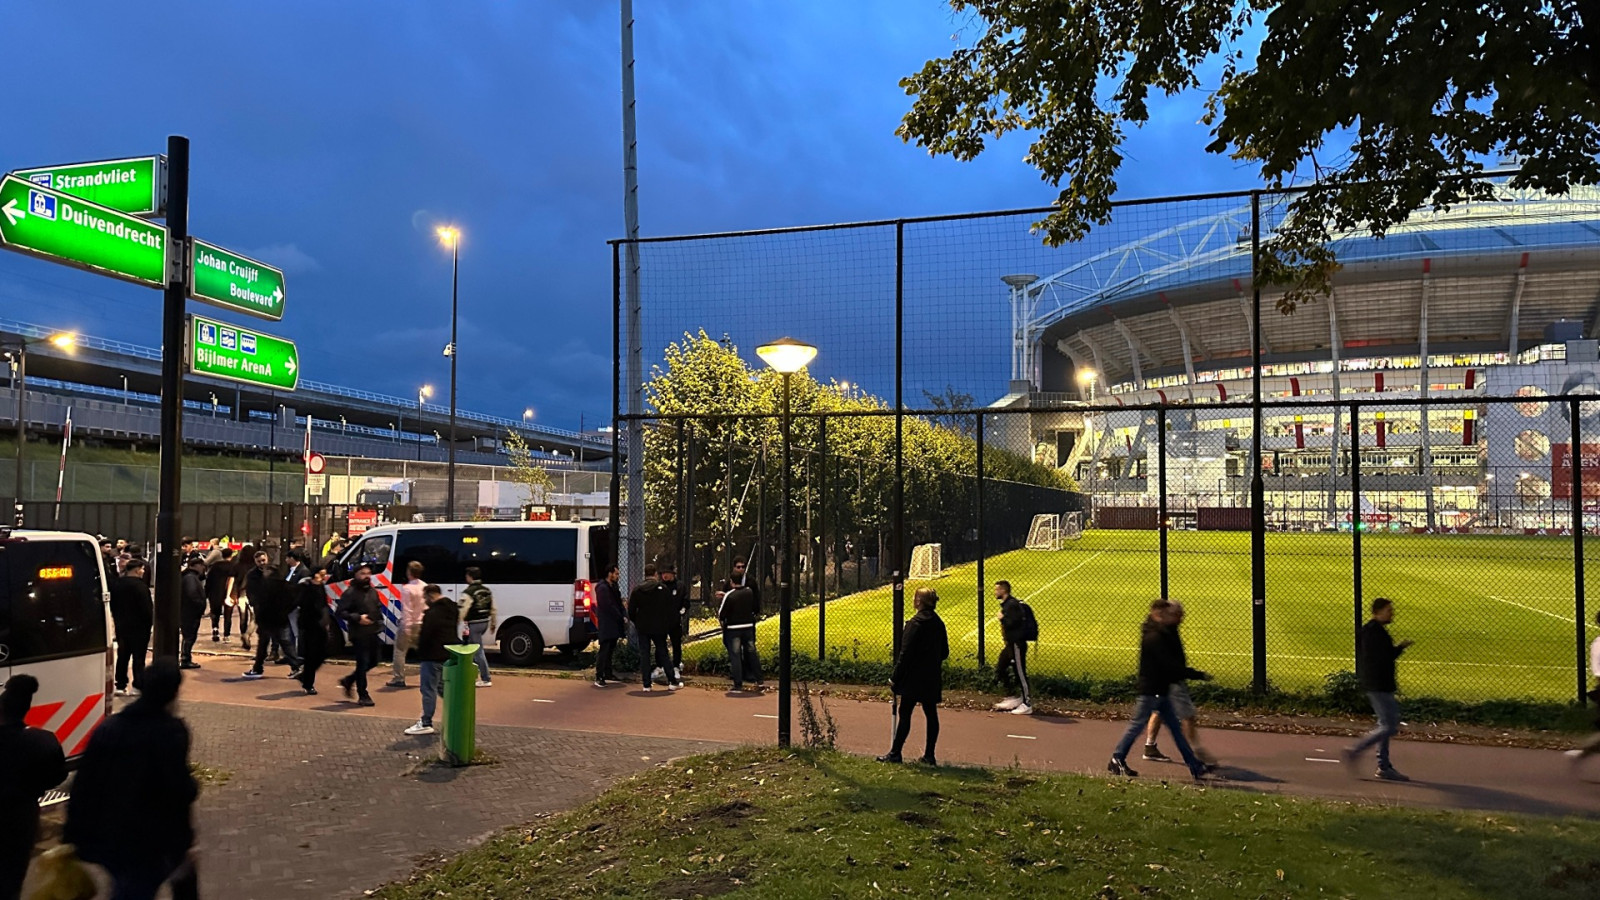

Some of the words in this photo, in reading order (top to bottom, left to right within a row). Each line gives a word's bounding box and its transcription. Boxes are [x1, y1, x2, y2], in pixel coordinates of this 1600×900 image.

[56, 168, 136, 189] Strandvliet
[61, 203, 161, 249] Duivendrecht
[198, 251, 227, 272] Johan
[229, 262, 258, 282] Cruijff
[230, 283, 273, 306] Boulevard
[197, 348, 238, 368] Bijlmer
[241, 358, 272, 376] ArenA
